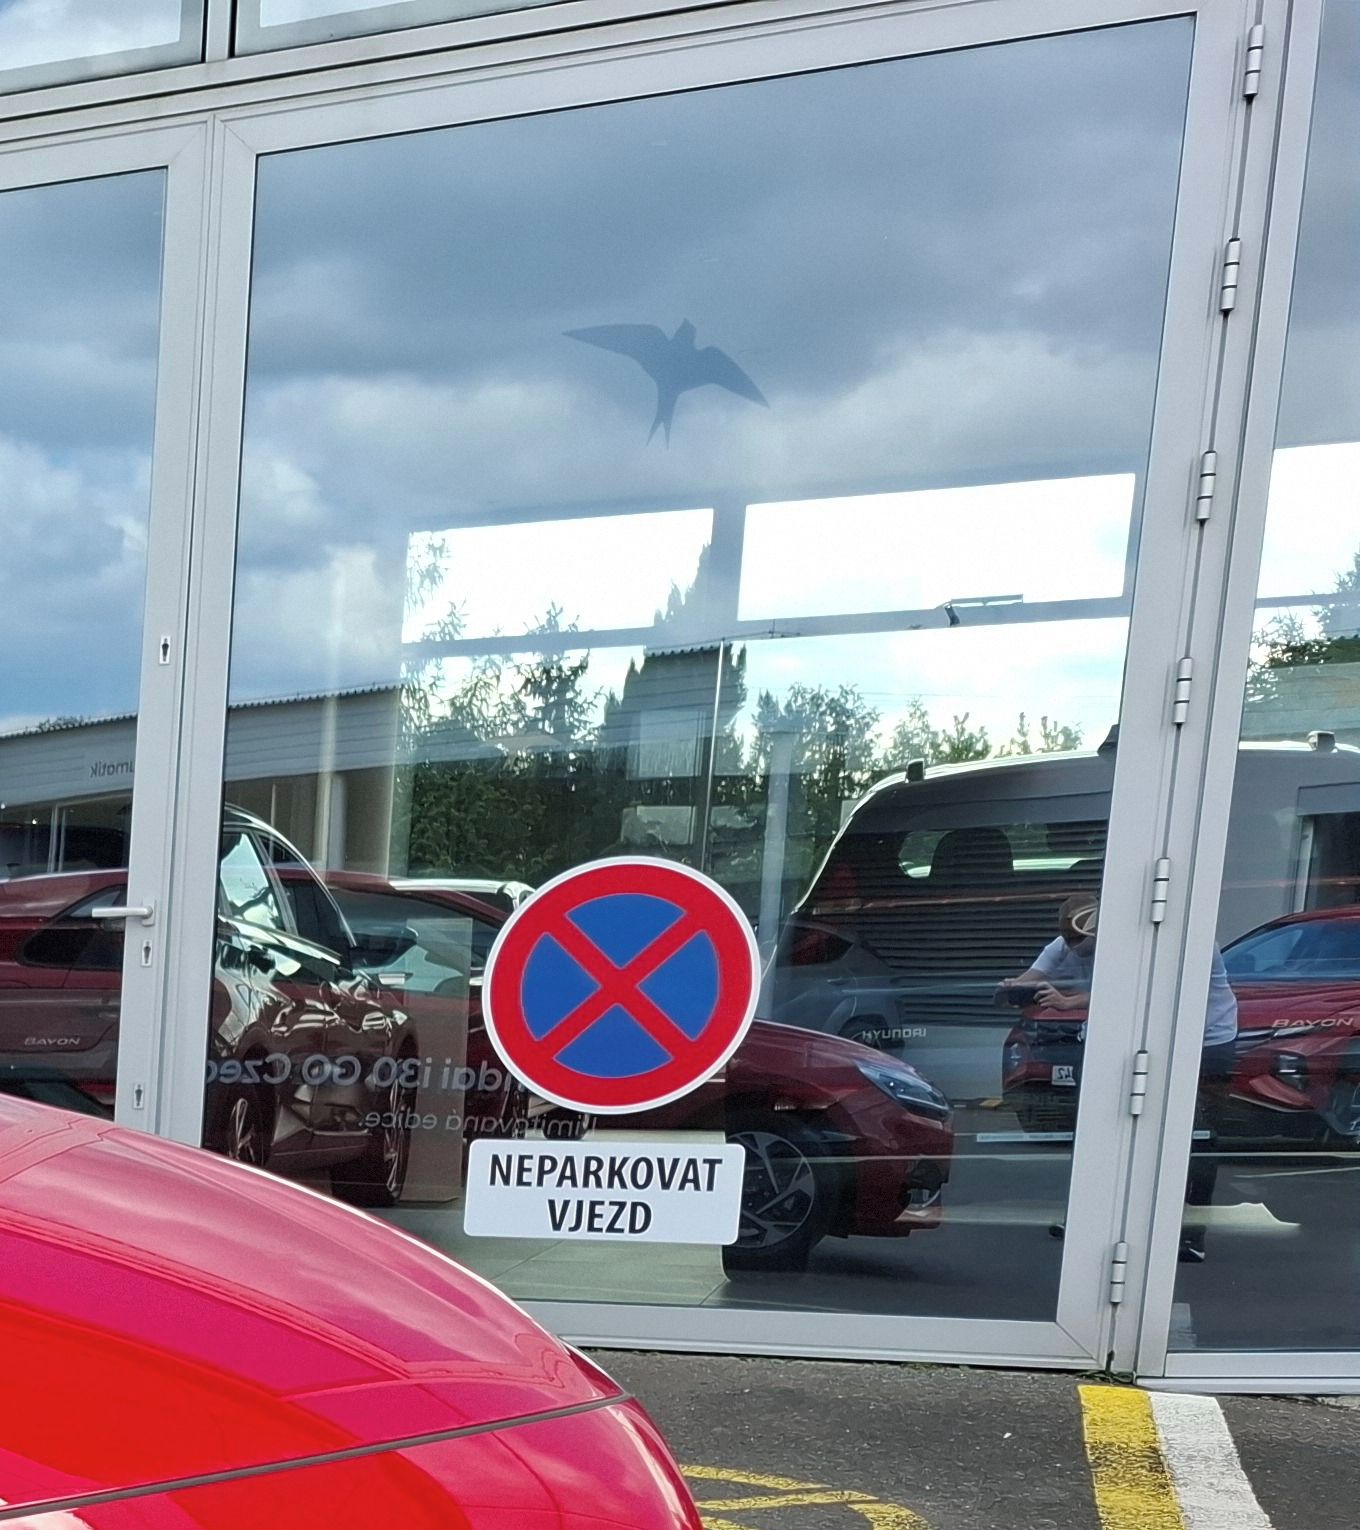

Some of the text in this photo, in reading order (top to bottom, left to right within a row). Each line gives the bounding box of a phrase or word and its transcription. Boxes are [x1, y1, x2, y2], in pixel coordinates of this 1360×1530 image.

[1272, 1018, 1354, 1028] BAYON
[862, 1028, 927, 1040] HYUNDAI
[23, 1036, 81, 1047] BAYON
[488, 1153, 723, 1192] NEPARKOVAT
[547, 1199, 653, 1235] VJEZD
